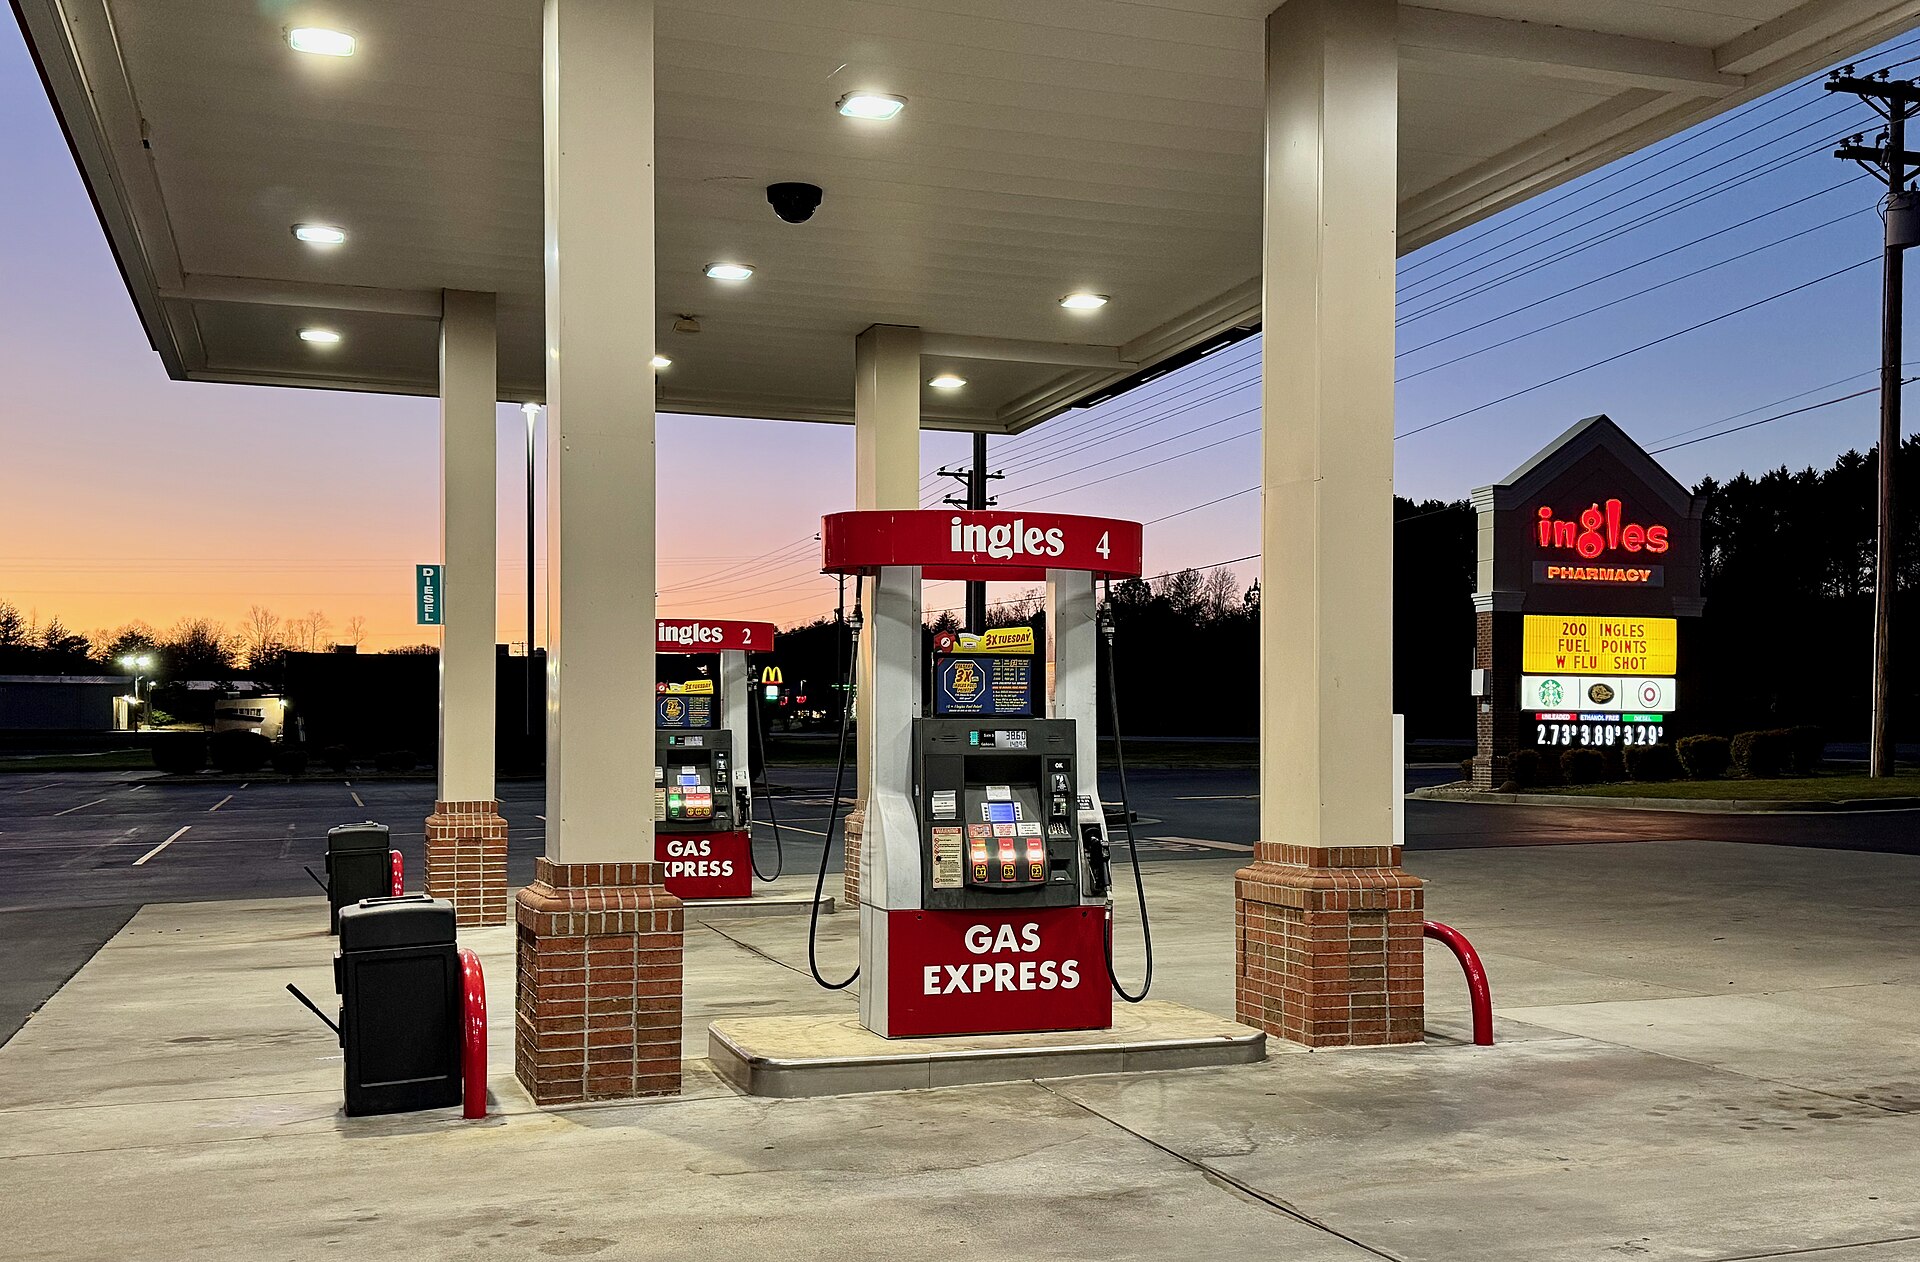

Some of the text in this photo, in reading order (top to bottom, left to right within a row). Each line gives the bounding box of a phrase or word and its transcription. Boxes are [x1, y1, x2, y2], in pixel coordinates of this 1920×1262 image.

[1538, 499, 1668, 559] ingles
[951, 516, 1111, 560] ingles 4
[1548, 566, 1651, 582] PHARMACY
[422, 567, 434, 621] DIESEL
[658, 622, 752, 645] ingles 2
[1562, 623, 1645, 637] 200 INGLES
[985, 634, 998, 646] 3X
[998, 632, 1032, 645] TUESDAY
[1558, 639, 1647, 653] FUEL POINTS
[1556, 655, 1647, 670] W FLU SHOT
[956, 669, 974, 682] 3X
[1605, 714, 1620, 722] FREE
[667, 840, 711, 857] GAS
[964, 922, 1041, 955] GAS
[923, 959, 1080, 995] EXPRESS
